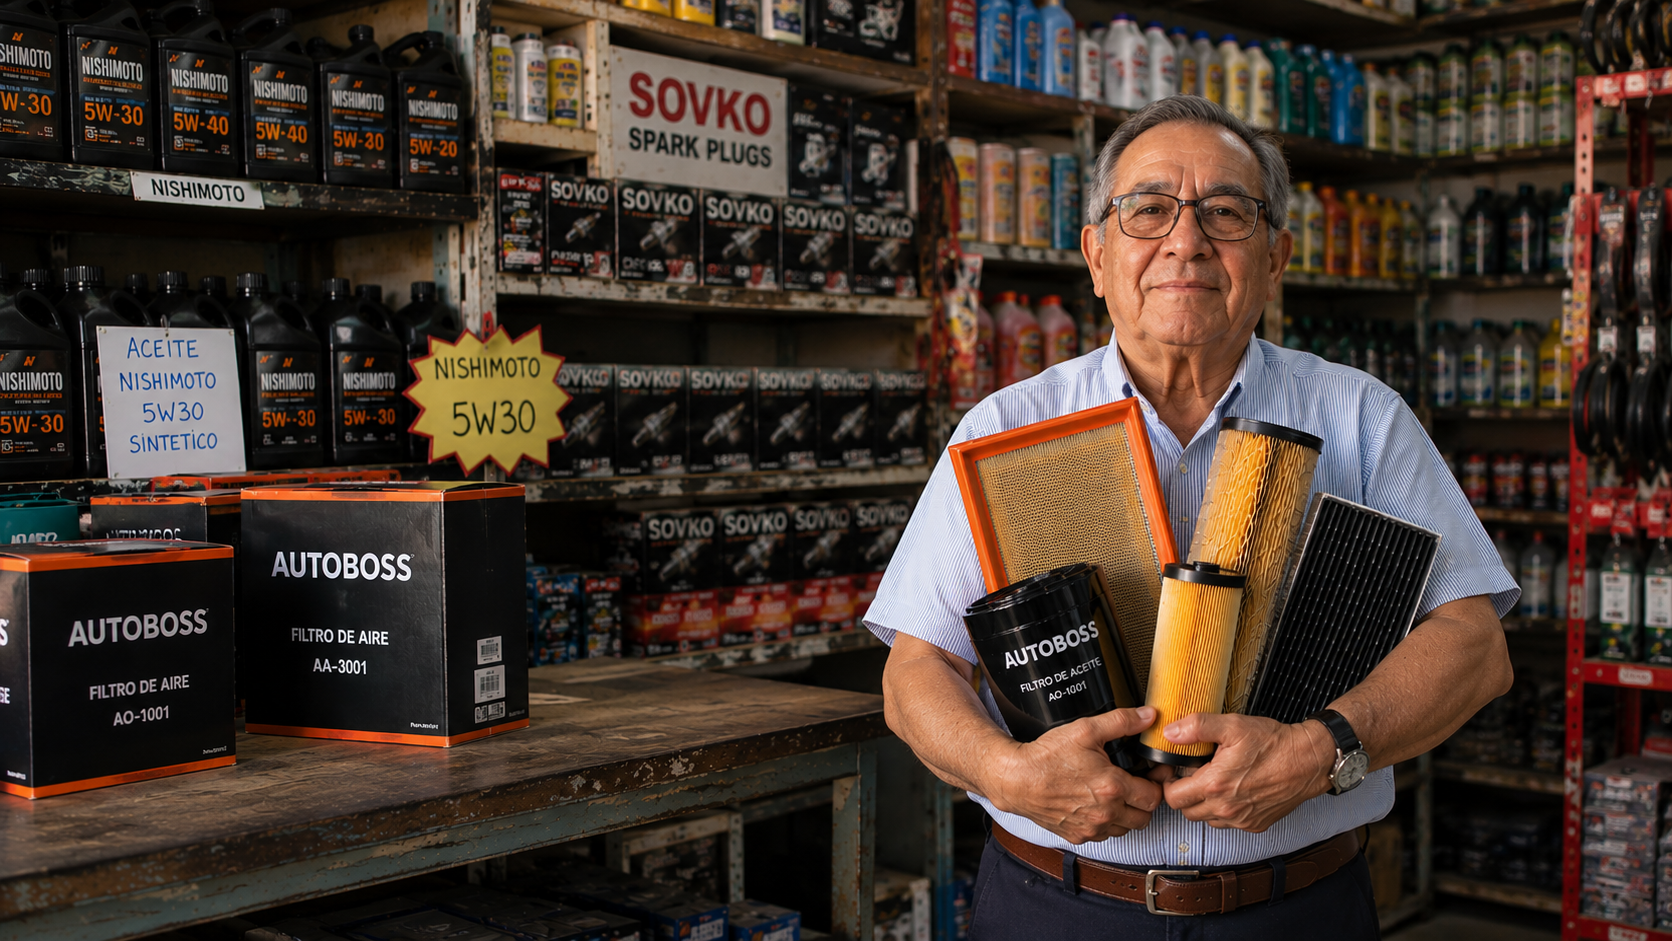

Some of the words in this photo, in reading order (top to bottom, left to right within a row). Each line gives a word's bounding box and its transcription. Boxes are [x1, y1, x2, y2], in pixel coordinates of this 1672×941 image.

[0, 43, 52, 70] SHIMOTO
[82, 56, 144, 82] NISHIMOTO
[171, 68, 229, 93] NISHIMOTO
[0, 91, 52, 116] W-30
[254, 79, 308, 104] NISHIMOTO
[332, 90, 385, 112] NISHIMOTO
[629, 71, 772, 136] SOVKO
[85, 102, 144, 126] 5W-30
[408, 99, 458, 120] NISHIMOTO
[174, 112, 229, 135] 5W-40
[256, 122, 308, 144] 5W-40
[629, 126, 700, 159] SPARK
[706, 135, 772, 168] PLUGS
[151, 178, 245, 202] NISHIMOTO
[551, 181, 609, 203] SOVKO
[622, 187, 694, 215] SOVKO
[706, 197, 774, 224] SOVKO
[783, 205, 846, 232] SOVKO
[854, 213, 914, 238] SOVKO
[127, 337, 199, 359] ACEITE
[434, 356, 541, 380] NISHIMOTO
[119, 371, 216, 392] NISHIMOTO
[261, 372, 316, 391] NISHIMOTO
[343, 372, 396, 390] NISHIMOTO
[0, 414, 64, 434] 5W-30
[143, 402, 204, 423] 5W30
[452, 400, 536, 436] 5W30
[724, 511, 788, 536] SOVKO
[795, 508, 850, 531] SOVKO
[856, 504, 909, 527] SOVKO
[649, 517, 714, 540] SOVKO
[271, 551, 412, 581] AUTOBOSS
[68, 608, 208, 647] AUTOBOSS
[291, 627, 334, 643] FILTRO
[338, 629, 355, 644] DE
[358, 630, 389, 645] AIRE
[1004, 620, 1100, 670] AUTOBOSS
[313, 658, 367, 675] AA-3001
[1020, 676, 1053, 693] FILTRO
[1054, 670, 1069, 683] DE
[1070, 656, 1102, 678] ACEITE
[89, 681, 136, 700] FILTRO
[139, 679, 157, 694] DE
[160, 675, 190, 692] AIRE
[1048, 680, 1087, 703] AO-1001
[113, 705, 170, 726] AO-1001
